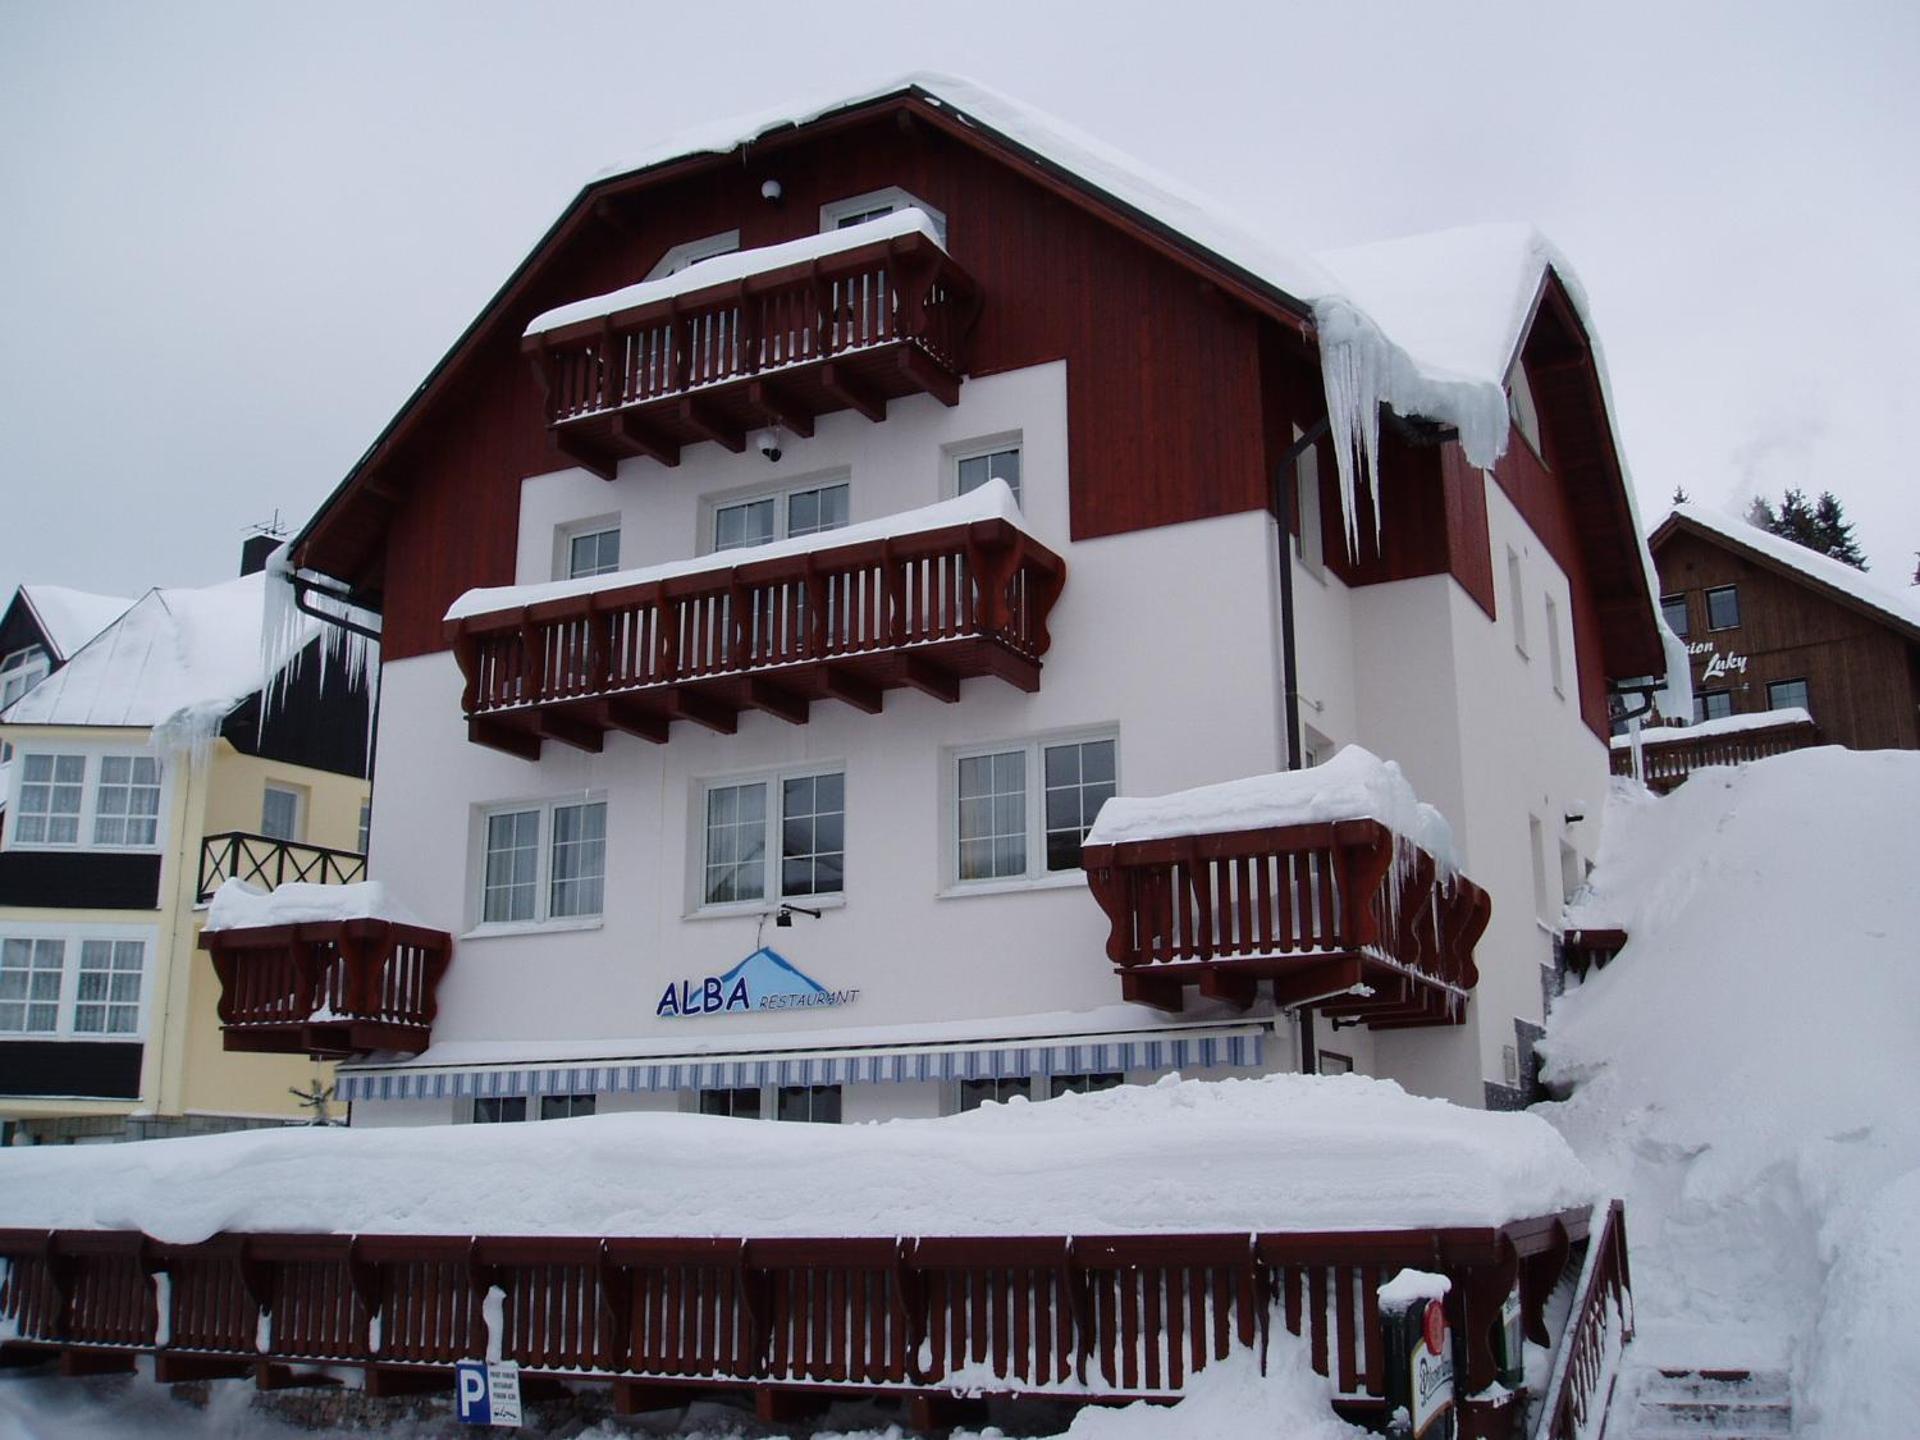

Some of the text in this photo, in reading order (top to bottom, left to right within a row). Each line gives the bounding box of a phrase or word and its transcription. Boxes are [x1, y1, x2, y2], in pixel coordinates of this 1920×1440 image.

[1702, 651, 1747, 682] Luky
[656, 976, 860, 1016] ALBA RESTAURANT
[460, 1369, 486, 1417] P
